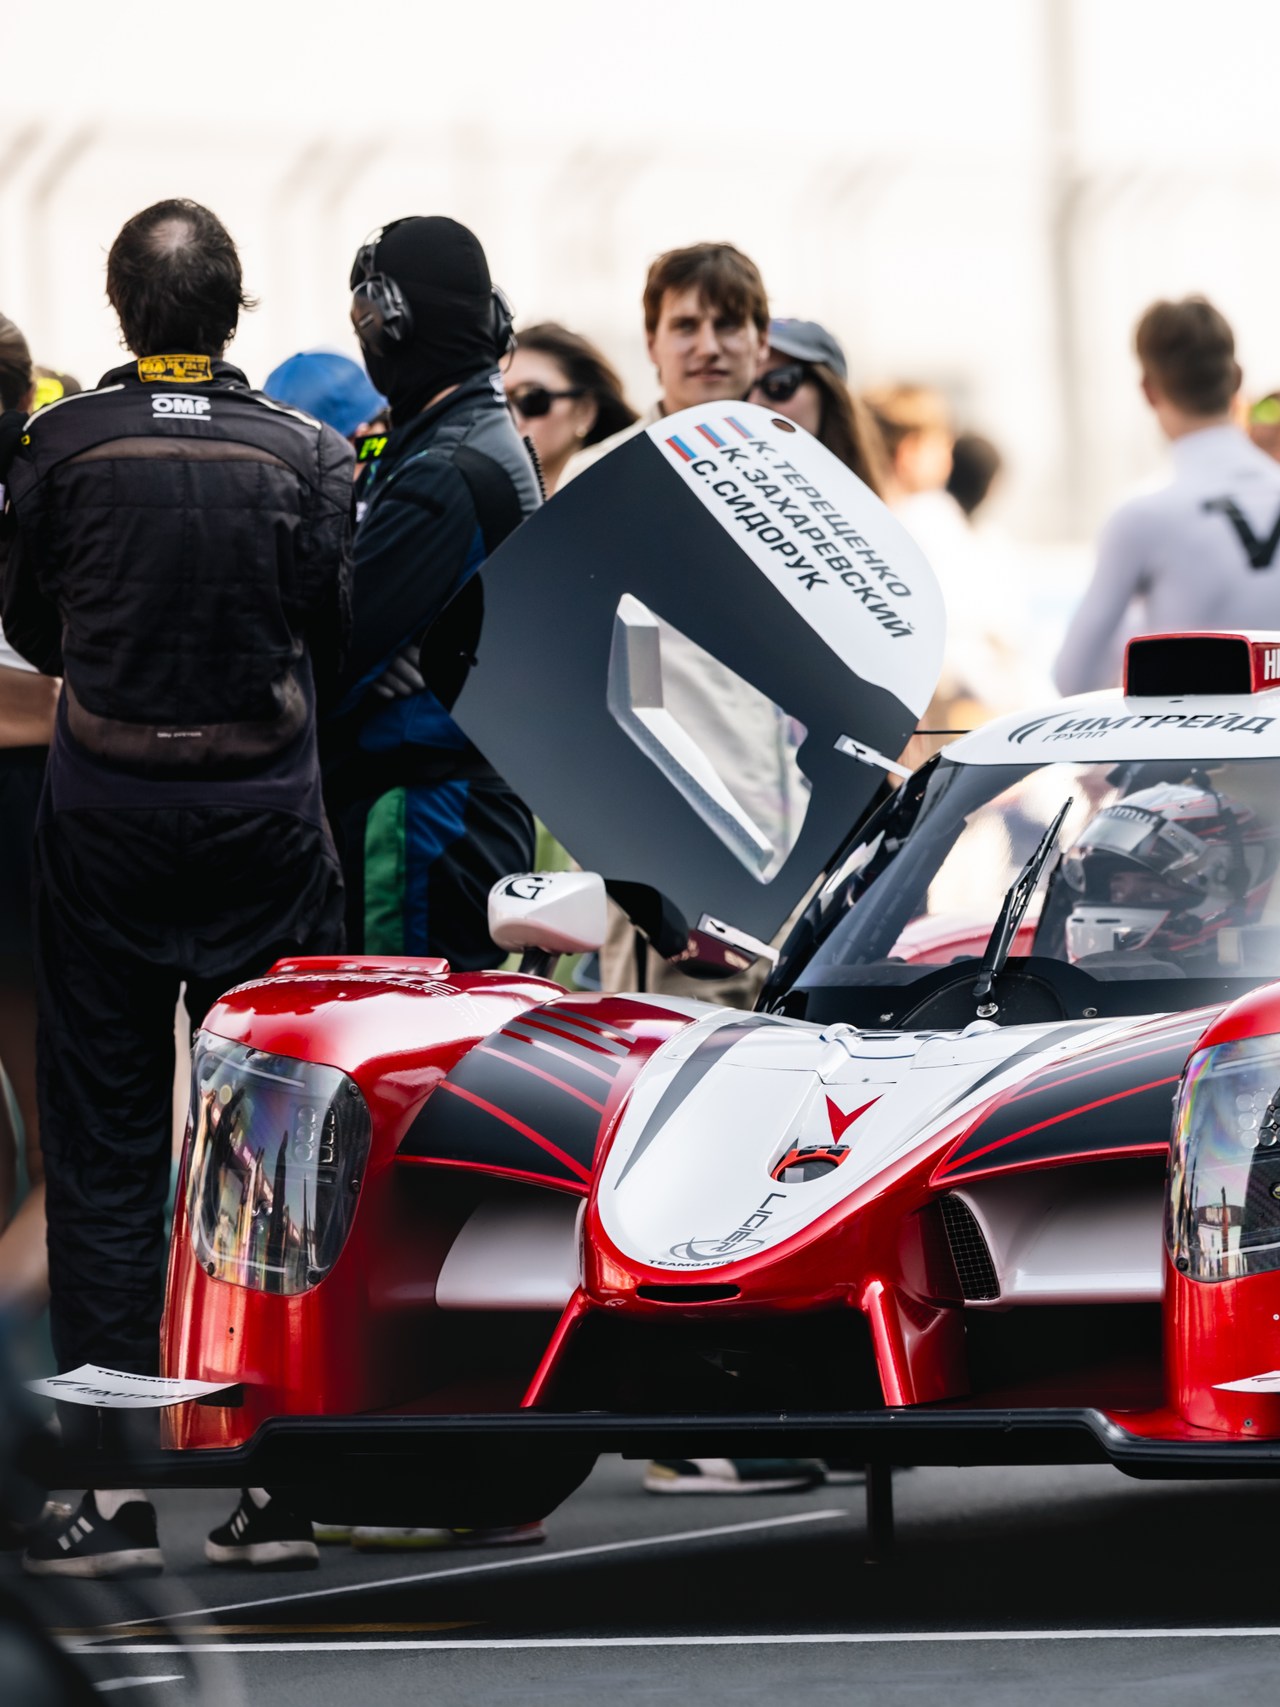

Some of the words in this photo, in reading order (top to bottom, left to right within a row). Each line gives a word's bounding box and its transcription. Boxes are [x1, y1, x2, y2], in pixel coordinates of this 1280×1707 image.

[152, 398, 211, 414] OMP
[691, 459, 829, 591] С.СИДОРУК
[1054, 712, 1277, 734] ИМТРЕЙД
